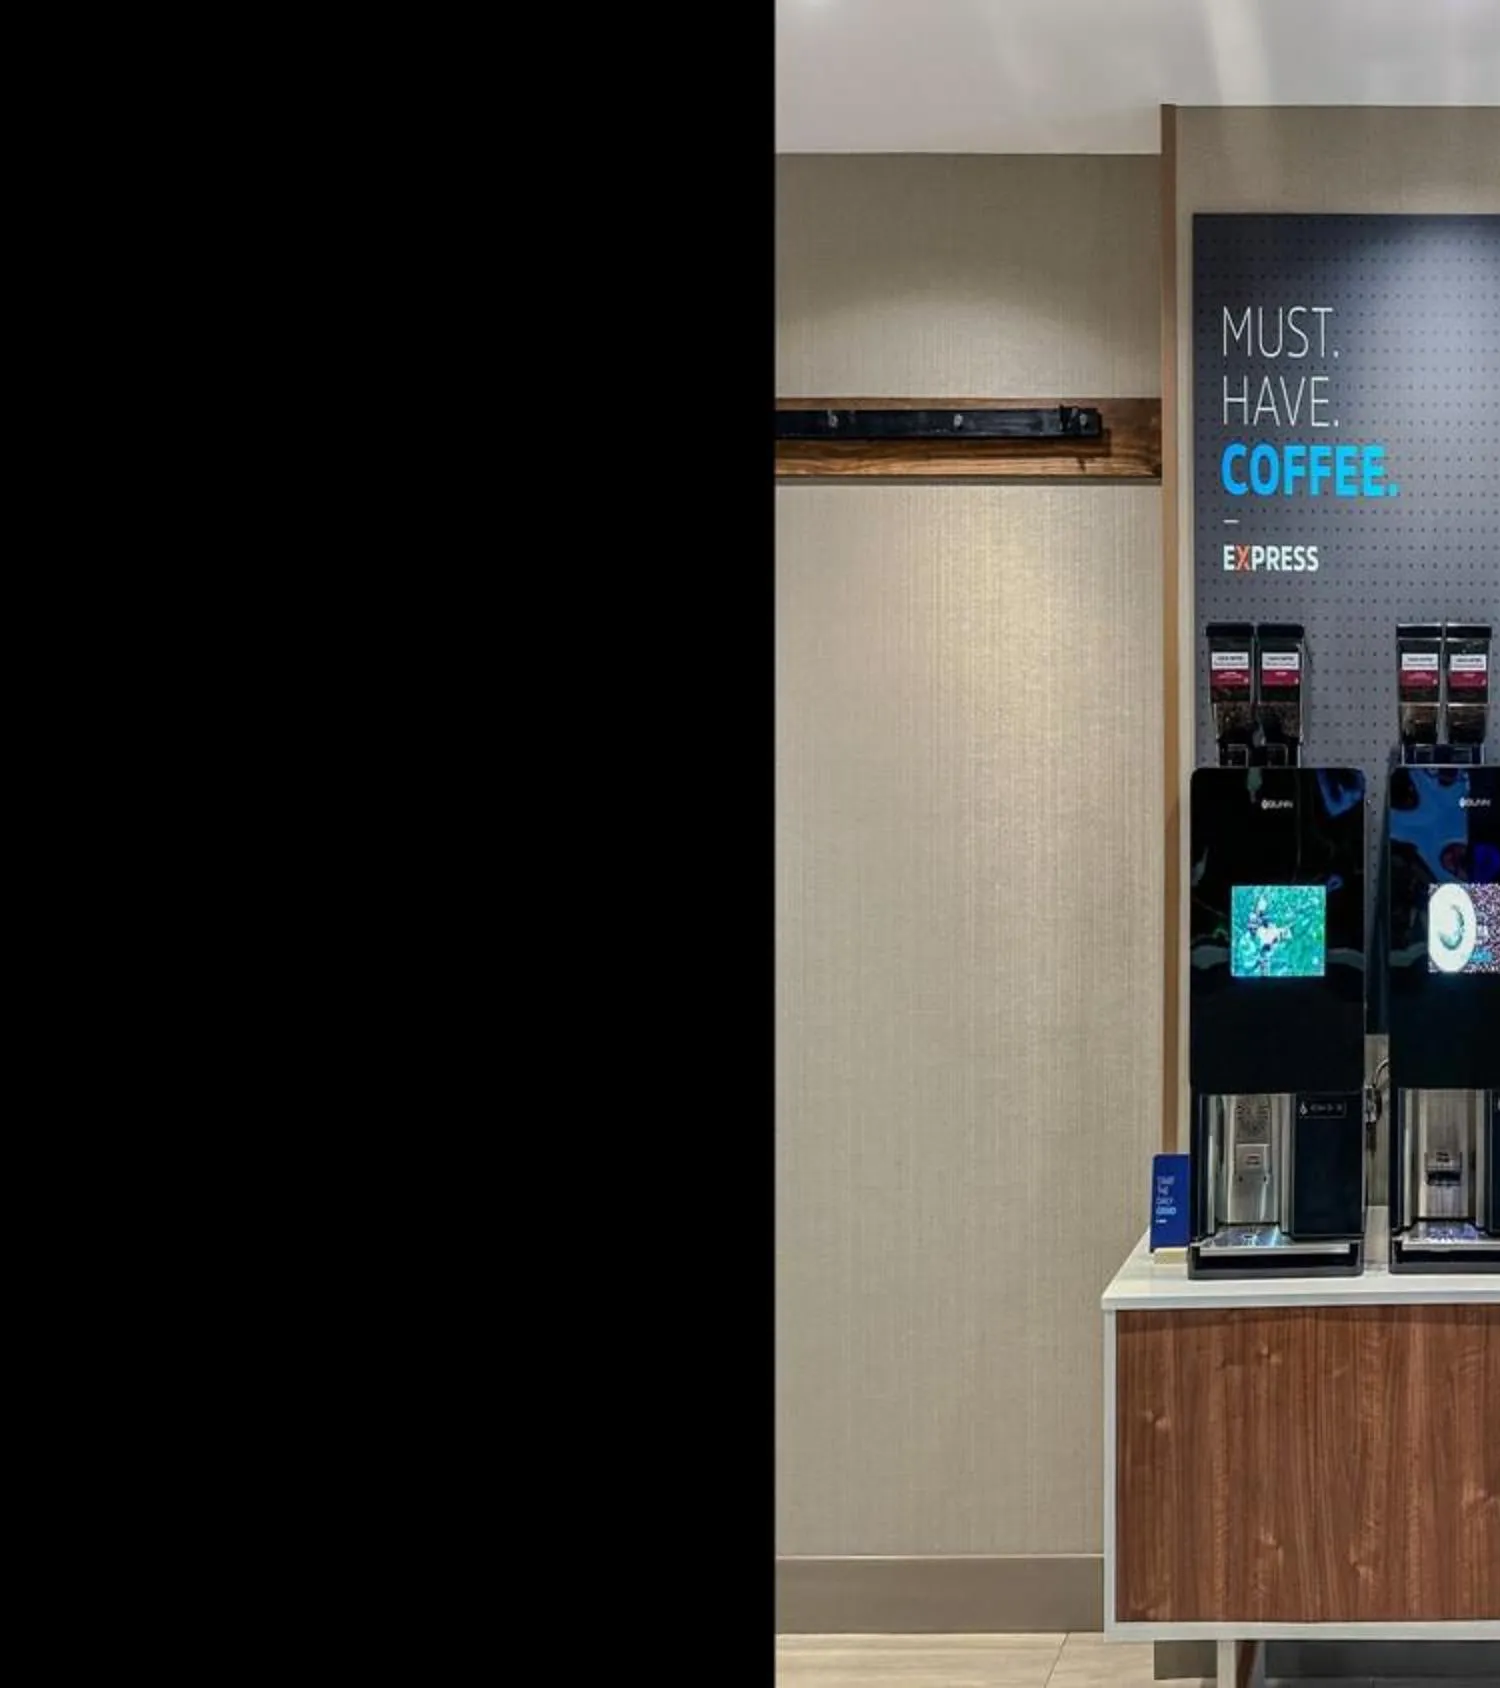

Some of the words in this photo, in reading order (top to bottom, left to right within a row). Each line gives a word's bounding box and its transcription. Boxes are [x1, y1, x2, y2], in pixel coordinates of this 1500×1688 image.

[1222, 305, 1340, 359] MUST.
[1222, 374, 1340, 428] HAVE.
[1220, 442, 1399, 497] COFFEE.
[1222, 544, 1320, 573] EXPRESS
